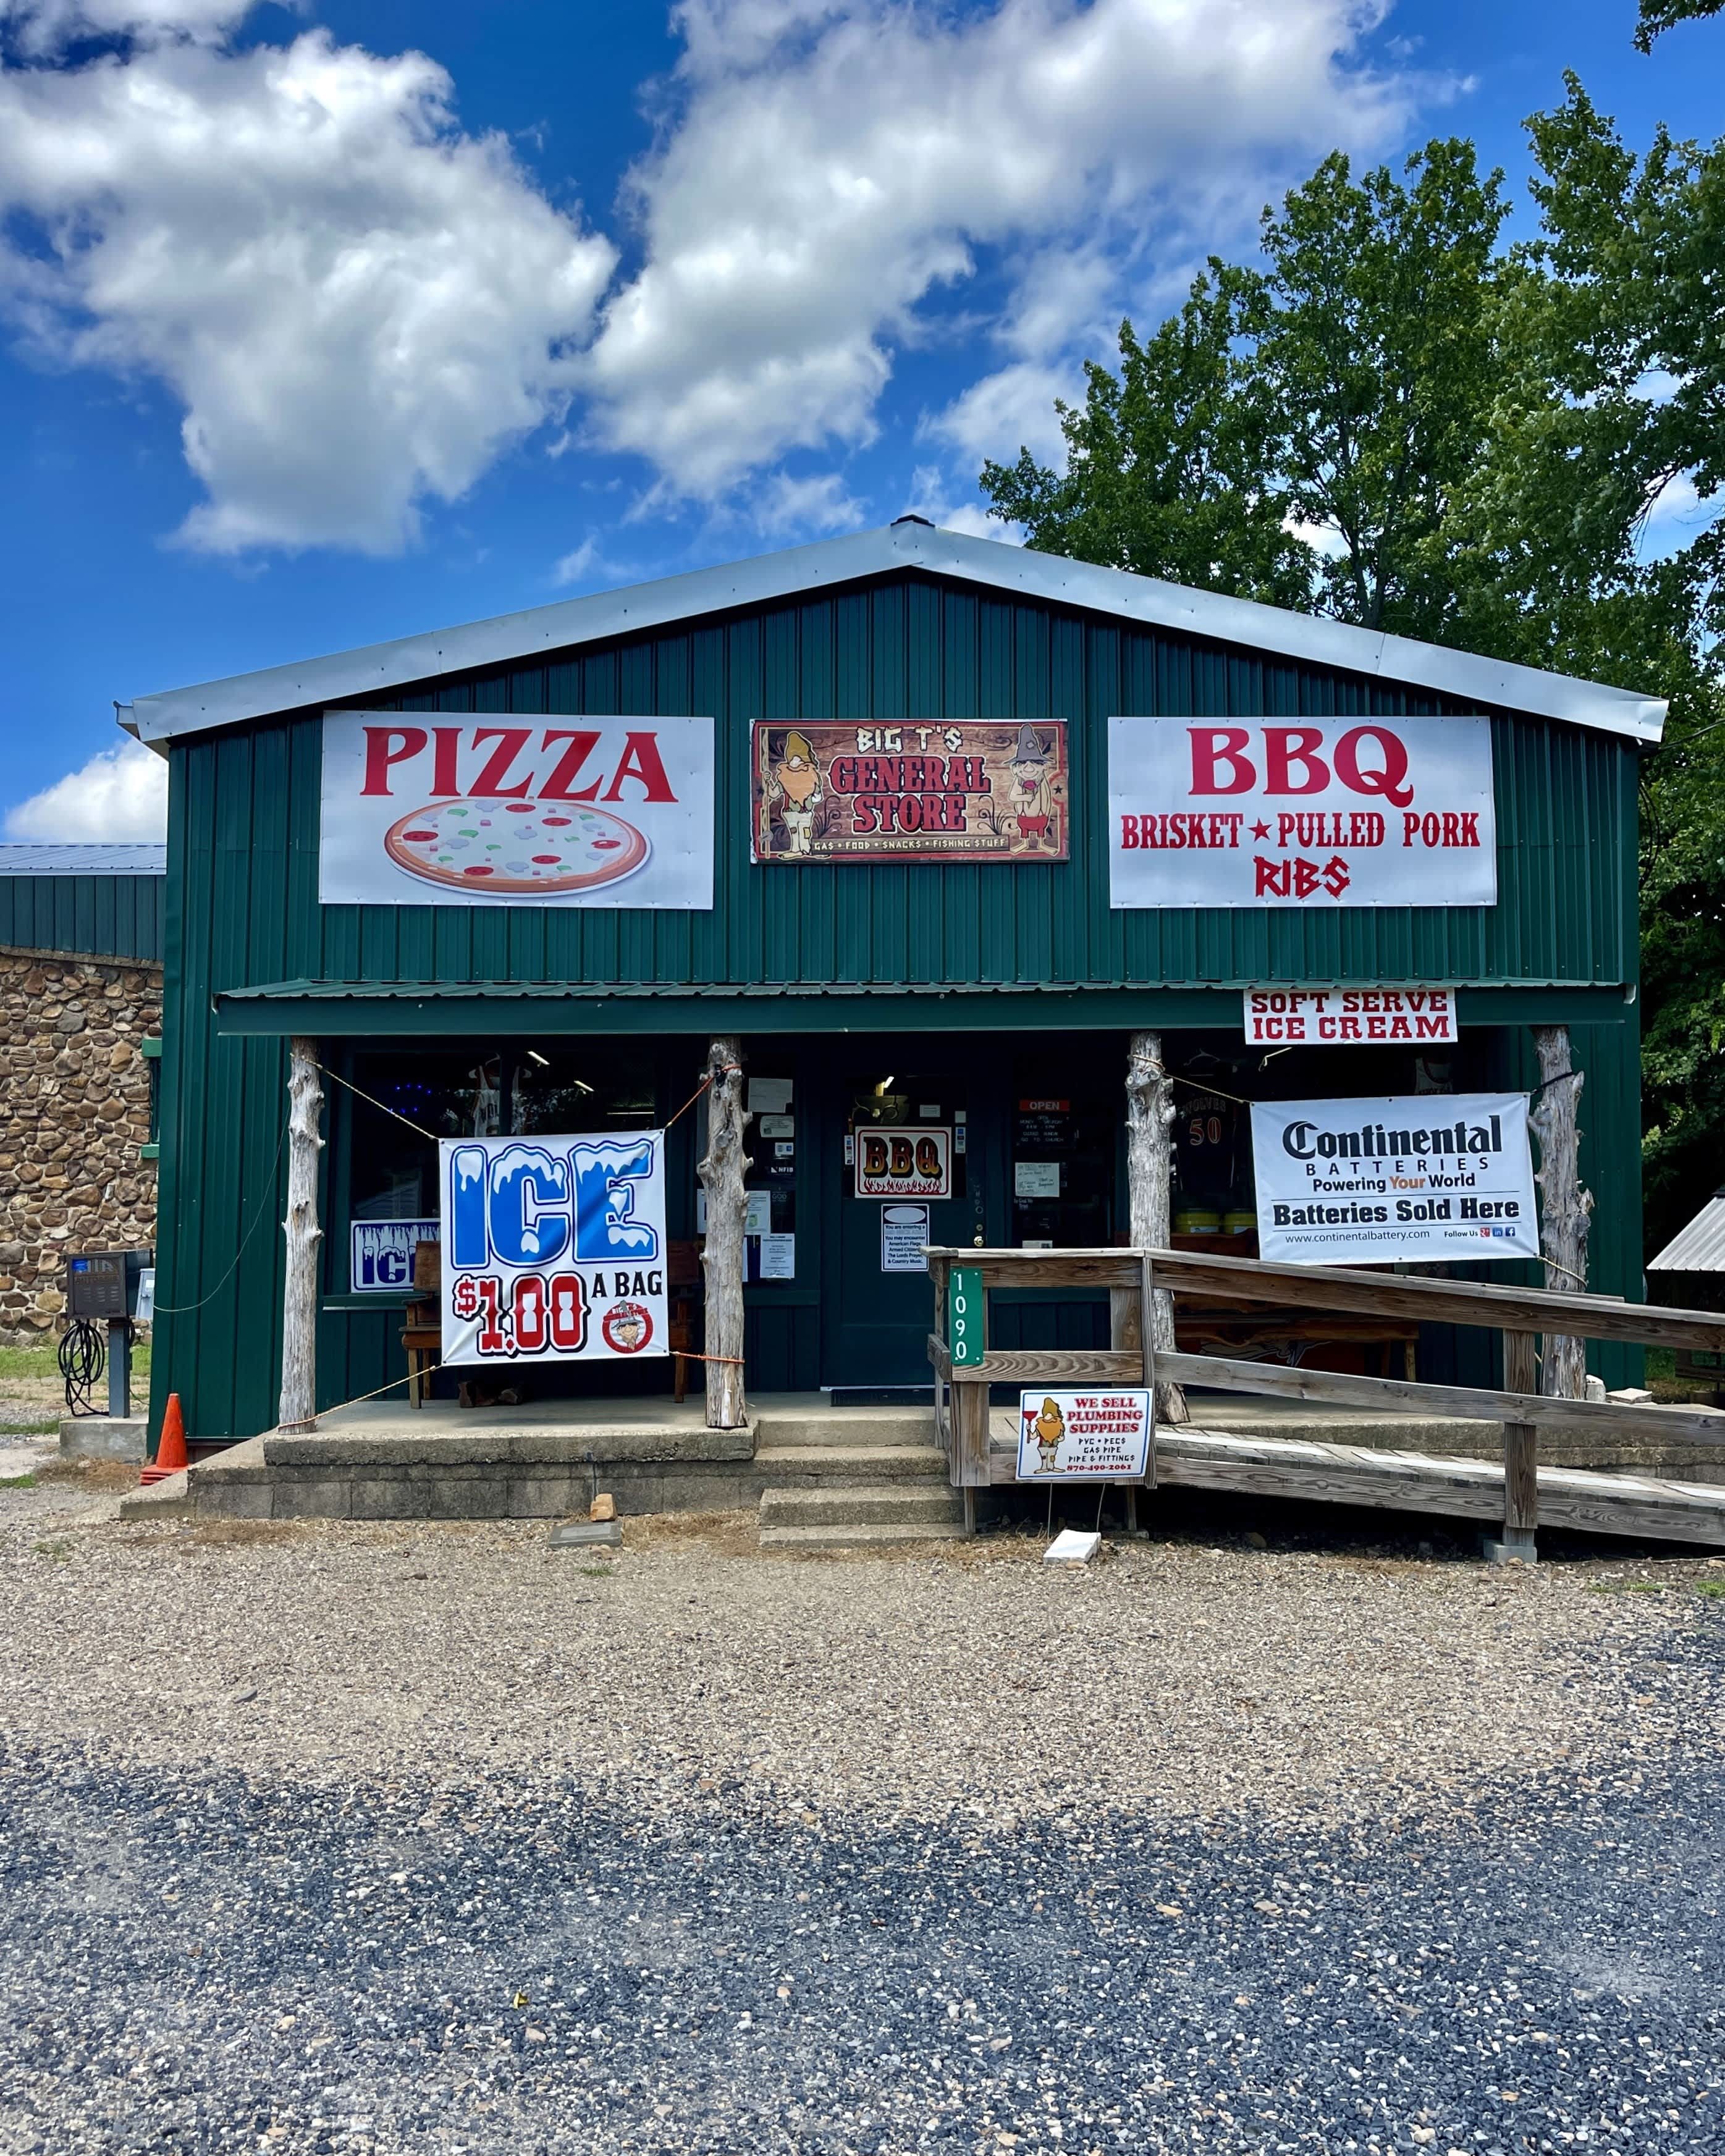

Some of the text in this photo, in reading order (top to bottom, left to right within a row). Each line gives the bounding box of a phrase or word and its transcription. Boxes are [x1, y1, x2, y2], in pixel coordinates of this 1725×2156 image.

[856, 722, 963, 752] BIG T'S
[360, 726, 679, 802] PIZZA
[827, 755, 992, 794] GENERAL
[1186, 725, 1414, 808] BBQ
[852, 794, 967, 833] STORE
[814, 838, 1007, 851] GAS FOOD SNACKS FISHING STUFF
[1121, 812, 1480, 849] BRISKET PULLED PORK
[1252, 854, 1351, 899] RIBS
[1251, 991, 1447, 1013] SOFT SERVE
[1253, 1016, 1449, 1040] ICE CREAM
[1029, 1102, 1060, 1110] OPEN
[1189, 1116, 1221, 1146] 50
[1282, 1114, 1503, 1160] Continental
[863, 1136, 943, 1179] BBQ
[1305, 1157, 1488, 1176] BATTERIES
[1313, 1173, 1475, 1193] Powering Your World
[450, 1139, 658, 1270] ICE
[1273, 1197, 1519, 1226] Batteries Sold Here
[1285, 1229, 1430, 1243] www.continentalbattery.com
[1444, 1230, 1467, 1238] Follow
[363, 1245, 416, 1284] IC
[453, 1270, 662, 1358] $1.00 A BAG
[955, 1274, 967, 1359] 1090
[1066, 1410, 1143, 1421] PLUMBING
[1074, 1397, 1137, 1409] WE SELL
[1069, 1423, 1139, 1434] SUPPLIES
[1078, 1438, 1094, 1446] PVC
